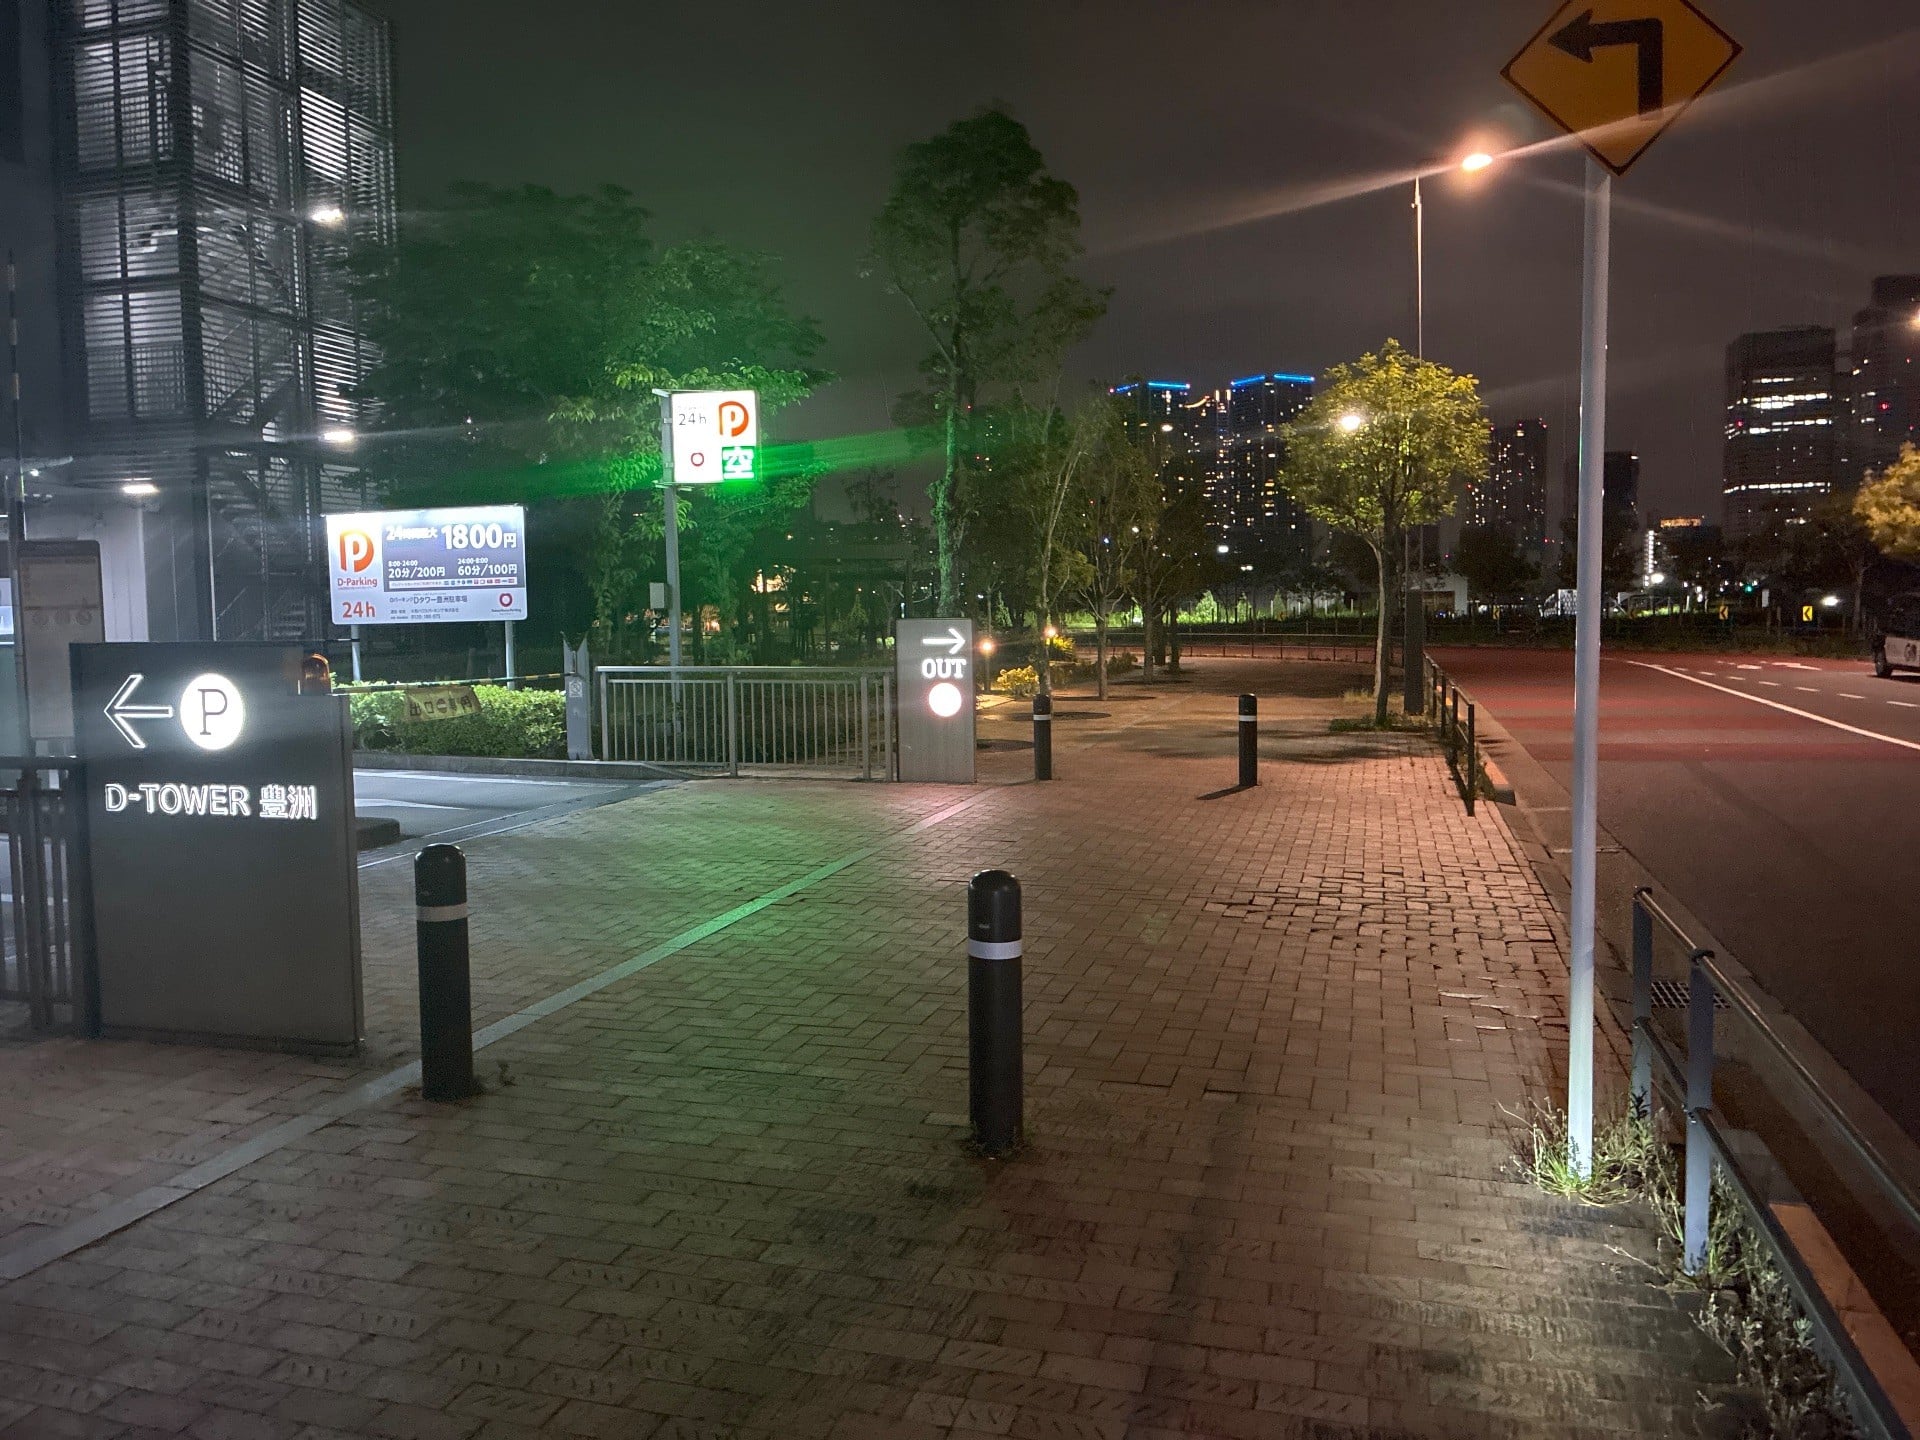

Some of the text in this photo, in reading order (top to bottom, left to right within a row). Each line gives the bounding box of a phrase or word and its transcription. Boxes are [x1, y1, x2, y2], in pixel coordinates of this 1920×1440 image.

[678, 413, 707, 426] 24h
[722, 447, 754, 479] 空
[441, 523, 517, 549] 1800円
[388, 566, 446, 579] 20分/200円
[457, 563, 518, 577] 60分/100円
[337, 577, 378, 588] D-Parking
[342, 601, 376, 619] 24h
[921, 658, 967, 679] OUT
[197, 688, 228, 736] P
[104, 783, 318, 820] D-TOWER 豊洲
